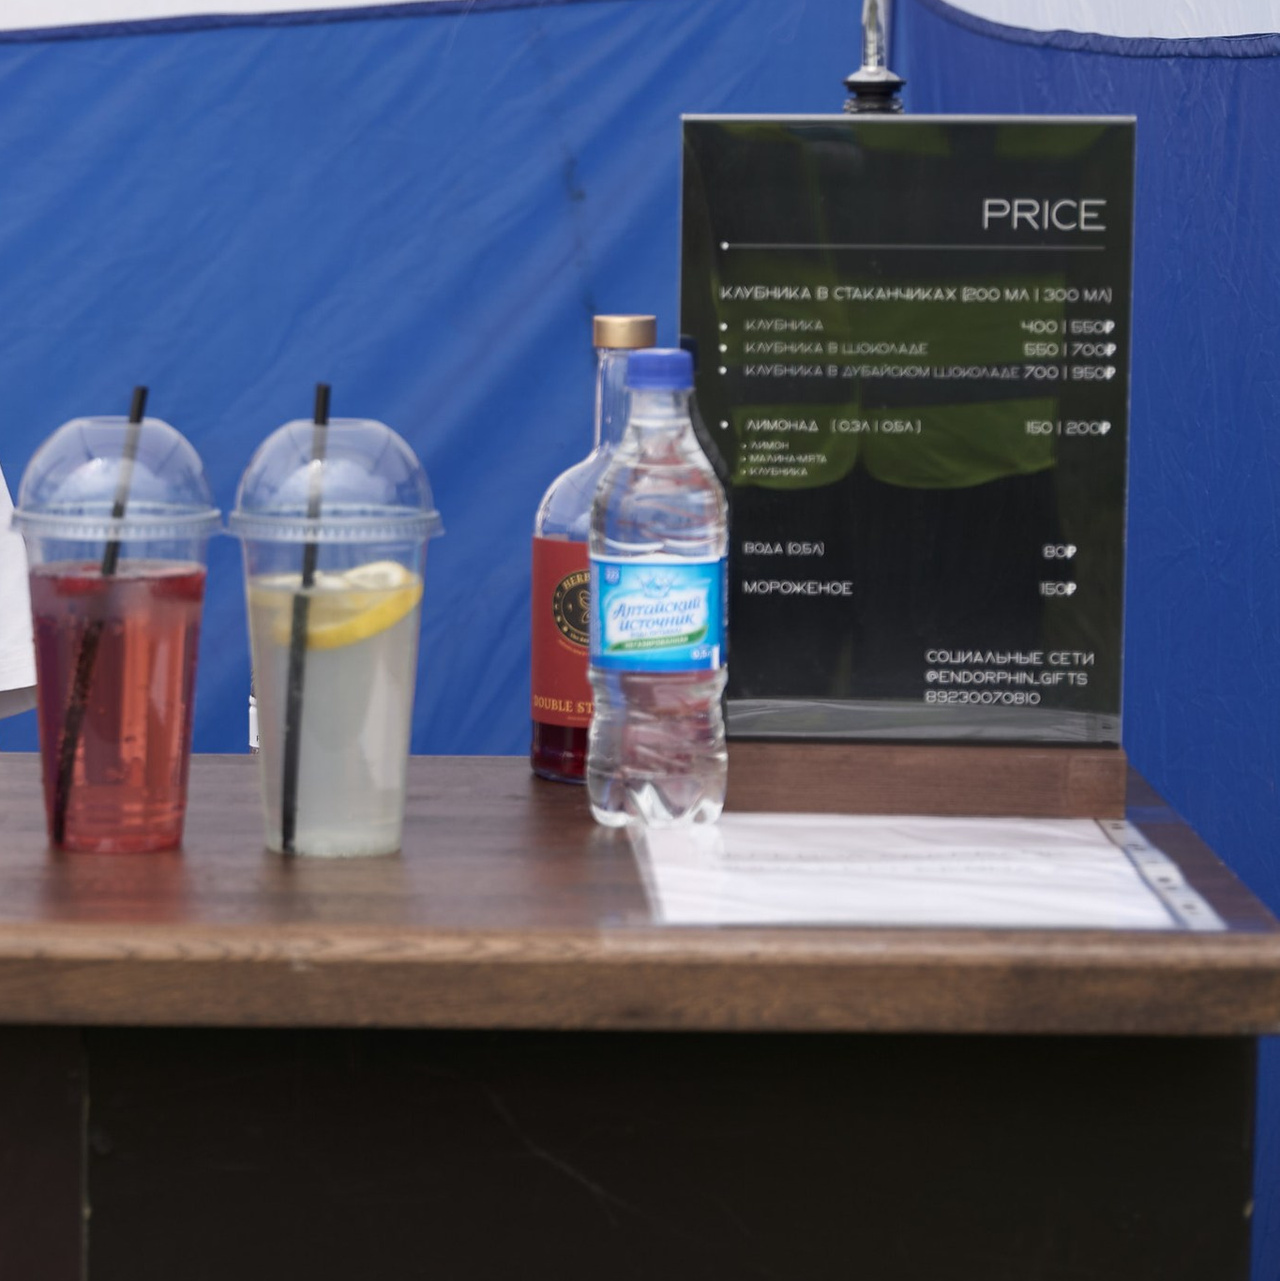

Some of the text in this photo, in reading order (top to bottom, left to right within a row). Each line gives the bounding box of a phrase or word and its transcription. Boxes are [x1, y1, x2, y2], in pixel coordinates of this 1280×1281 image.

[983, 198, 1107, 231] PRICE
[721, 286, 811, 301] КЛУБНИКА
[817, 286, 829, 301] В
[833, 286, 957, 302] СТАКАНЧИКАХ
[1004, 288, 1031, 302] МЛ
[1044, 288, 1080, 302] 300
[745, 319, 824, 331] КЛУБНИКА
[1022, 321, 1059, 334] 400
[745, 342, 824, 354] КЛУБНИКА
[828, 342, 838, 354] В
[842, 342, 928, 355] ШОКОЛАДЕ
[1024, 343, 1059, 356] 550
[745, 365, 824, 377] КЛУБНИКА
[828, 365, 838, 377] В
[842, 363, 930, 378] ДУБАЙСКОМ
[933, 366, 1020, 379] ШОКОЛАДЕ
[1024, 366, 1059, 379] 700
[747, 420, 819, 432] ЛИМОНАД
[1026, 421, 1053, 434] 150
[750, 441, 789, 451] ЛИМОН
[750, 454, 828, 464] МАЛИНА-МЯТА
[750, 467, 808, 477] КЛУБНИКА
[744, 542, 783, 555] ВОДА
[744, 581, 853, 595] МОРОЖЕНОЕ
[926, 651, 1095, 666] СОЦИАЛЬНЫЕ СЕТИ
[534, 695, 594, 715] DOUBLE ST
[926, 691, 1042, 705] 89230070810
